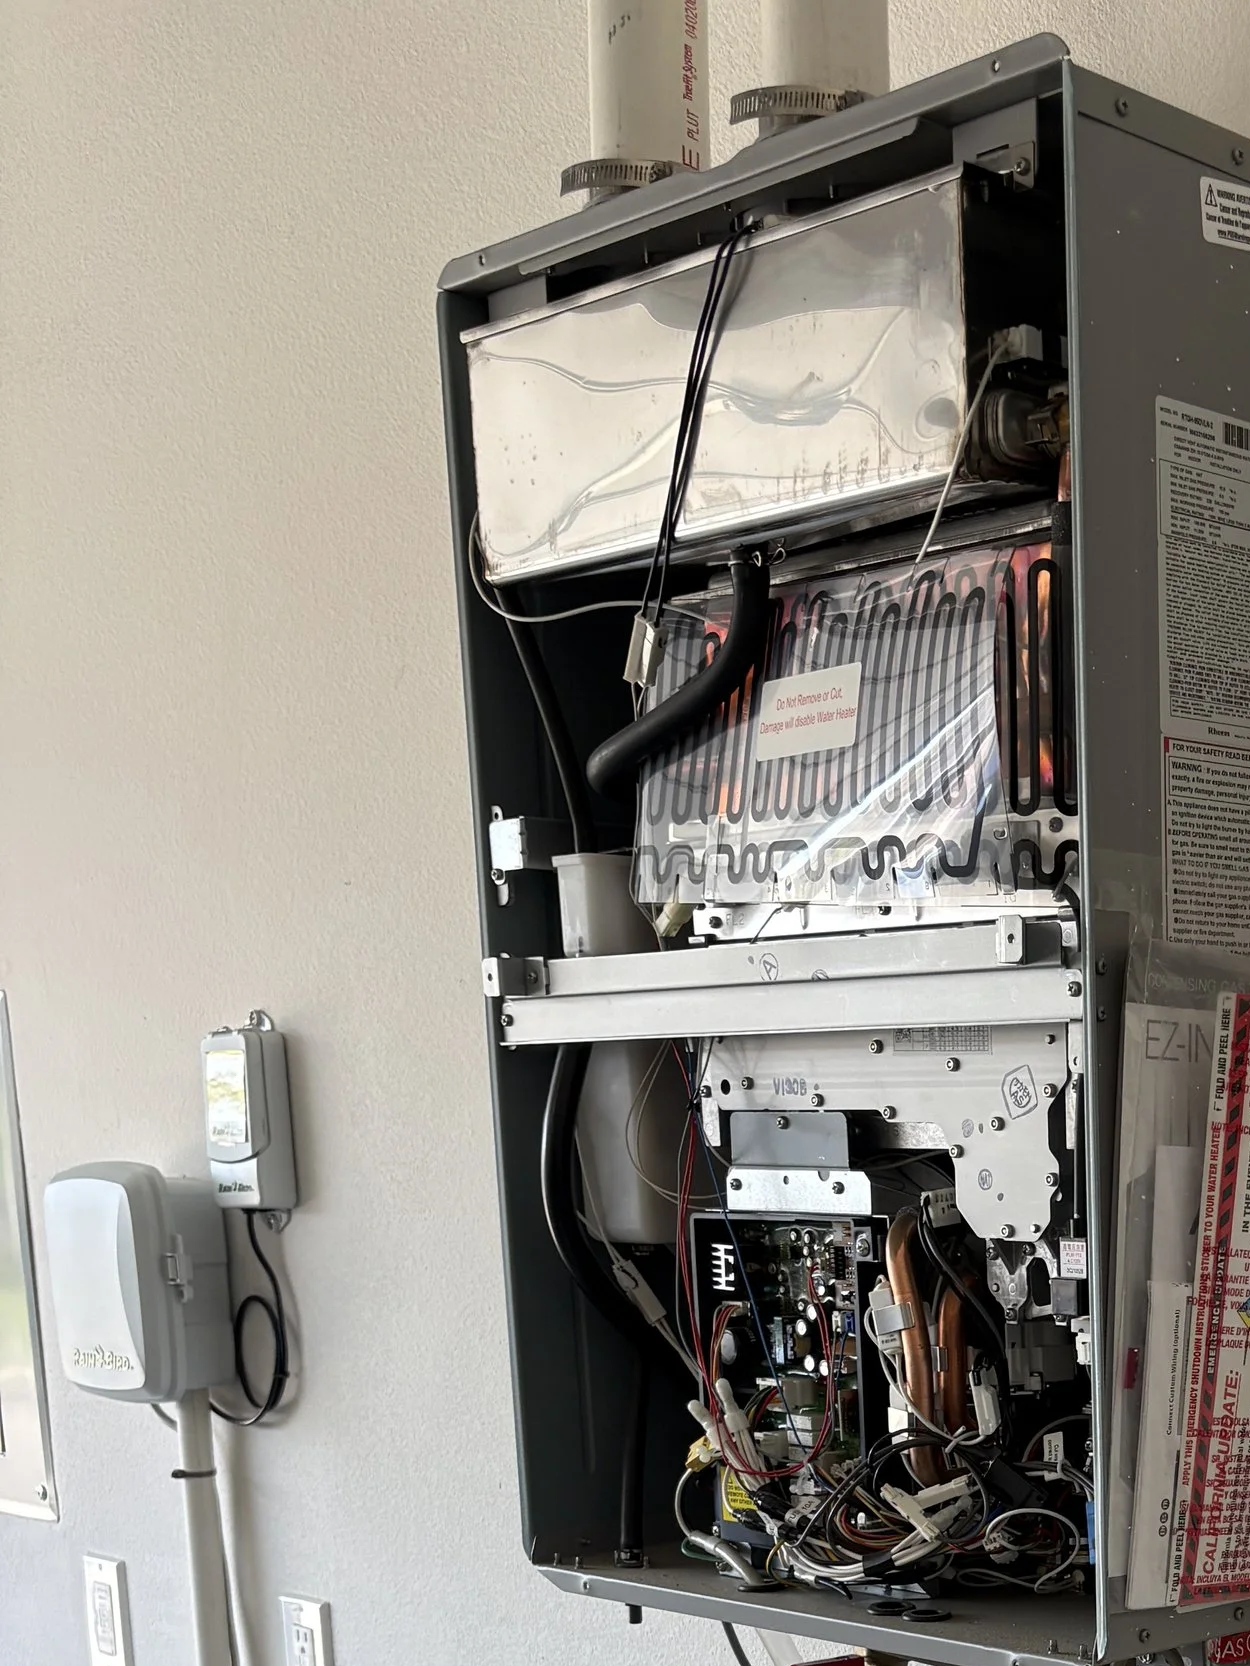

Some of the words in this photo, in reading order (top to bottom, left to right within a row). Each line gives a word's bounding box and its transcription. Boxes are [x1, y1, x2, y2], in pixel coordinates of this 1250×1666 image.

[776, 699, 785, 711] Do
[786, 696, 797, 708] Not
[797, 692, 822, 707] Remove
[823, 692, 830, 701] or
[760, 720, 784, 734] Damage
[785, 717, 794, 728] will
[795, 715, 816, 728] disable
[817, 711, 835, 723] Water
[836, 707, 856, 720] Heater
[1208, 726, 1230, 738] Rheem
[1173, 743, 1185, 753] FOR
[1186, 745, 1202, 755] YOUR
[1203, 748, 1225, 758] SAFETY
[1225, 751, 1240, 761] READ
[1172, 760, 1202, 772] WARNING
[1222, 1008, 1231, 1031] HERE
[1219, 1033, 1229, 1056] PEEL
[1217, 1057, 1227, 1078] AND
[1215, 1079, 1225, 1100] FOLD
[1207, 1163, 1218, 1193] WATER
[1205, 1195, 1216, 1219] YOUR
[1204, 1220, 1213, 1233] TO
[1241, 1222, 1250, 1233] IN
[1190, 1337, 1202, 1385] SHUTDOWN
[1186, 1387, 1198, 1438] EMERGENCY
[1184, 1440, 1193, 1459] THIS
[1181, 1460, 1191, 1486] APPLY
[1175, 1532, 1184, 1552] PEEL
[1173, 1554, 1182, 1570] AND
[1171, 1573, 1180, 1592] FOLD
